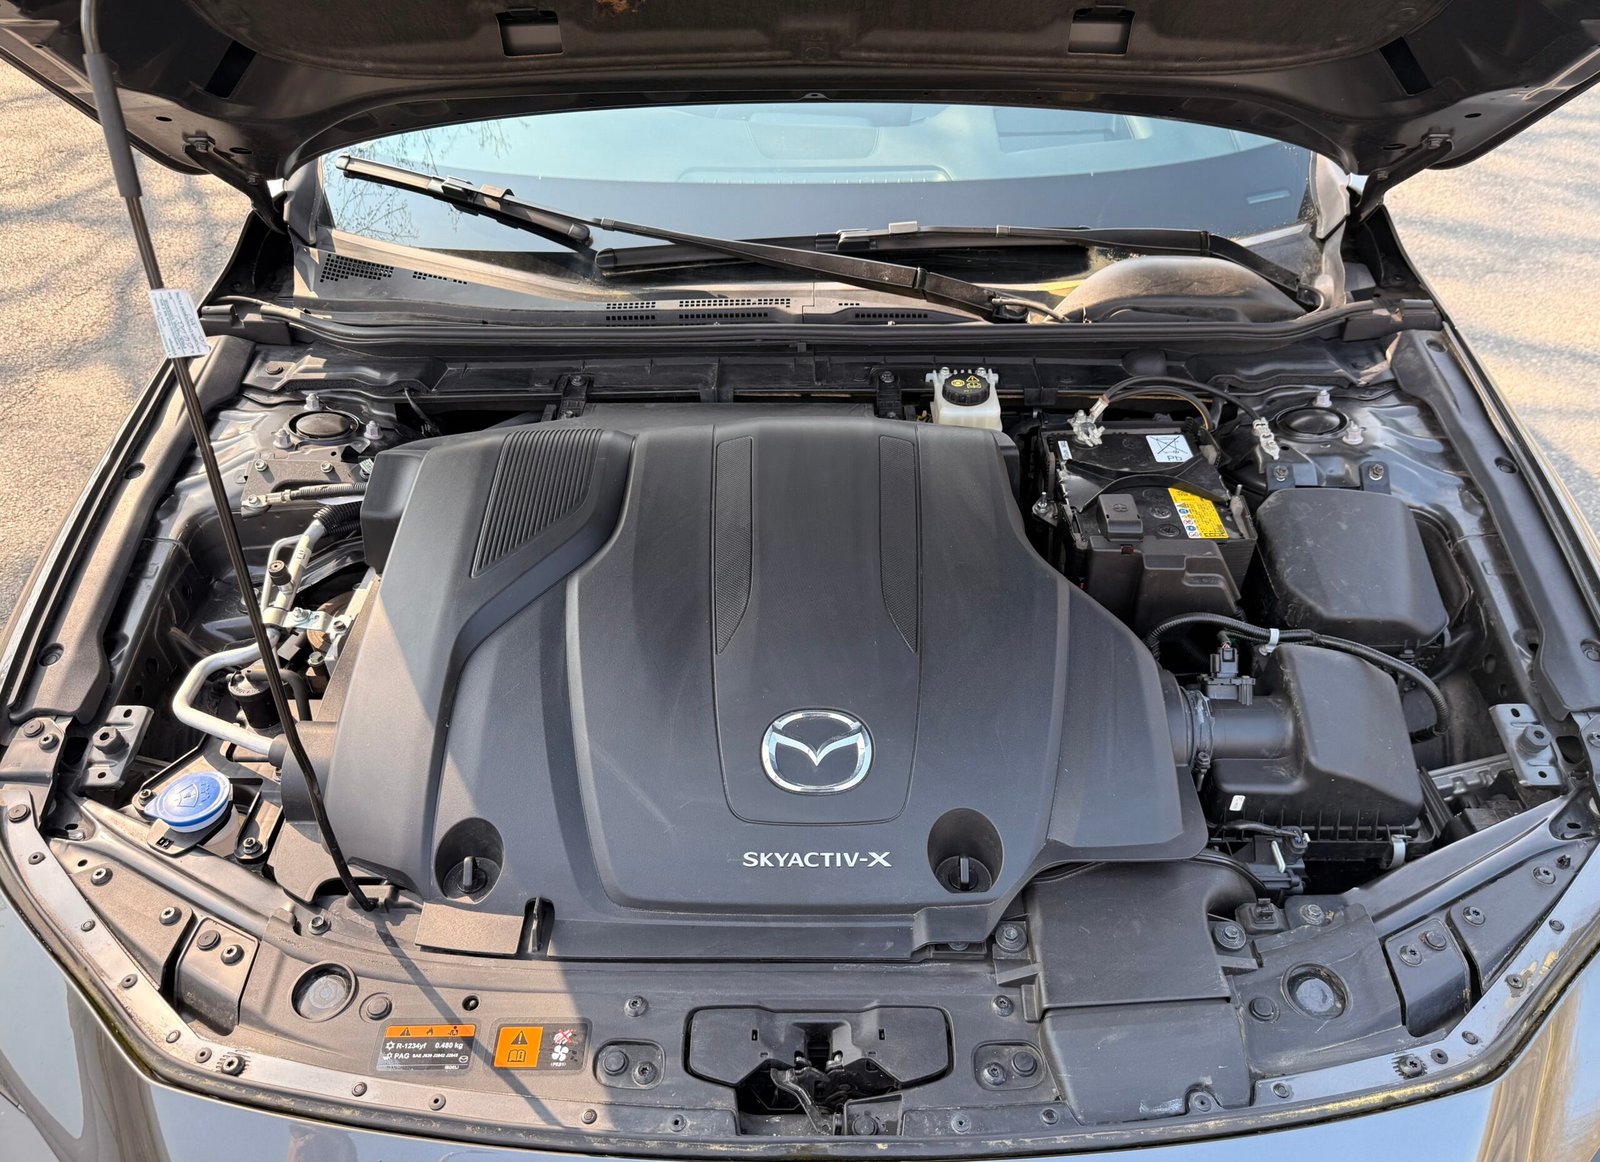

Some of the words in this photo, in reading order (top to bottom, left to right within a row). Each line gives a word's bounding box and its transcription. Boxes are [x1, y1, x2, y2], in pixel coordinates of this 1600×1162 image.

[742, 851, 893, 868] SKYACTIV-X
[396, 1042, 428, 1050] R-1234yf
[454, 1042, 464, 1050] kg
[393, 1052, 410, 1060] PAG
